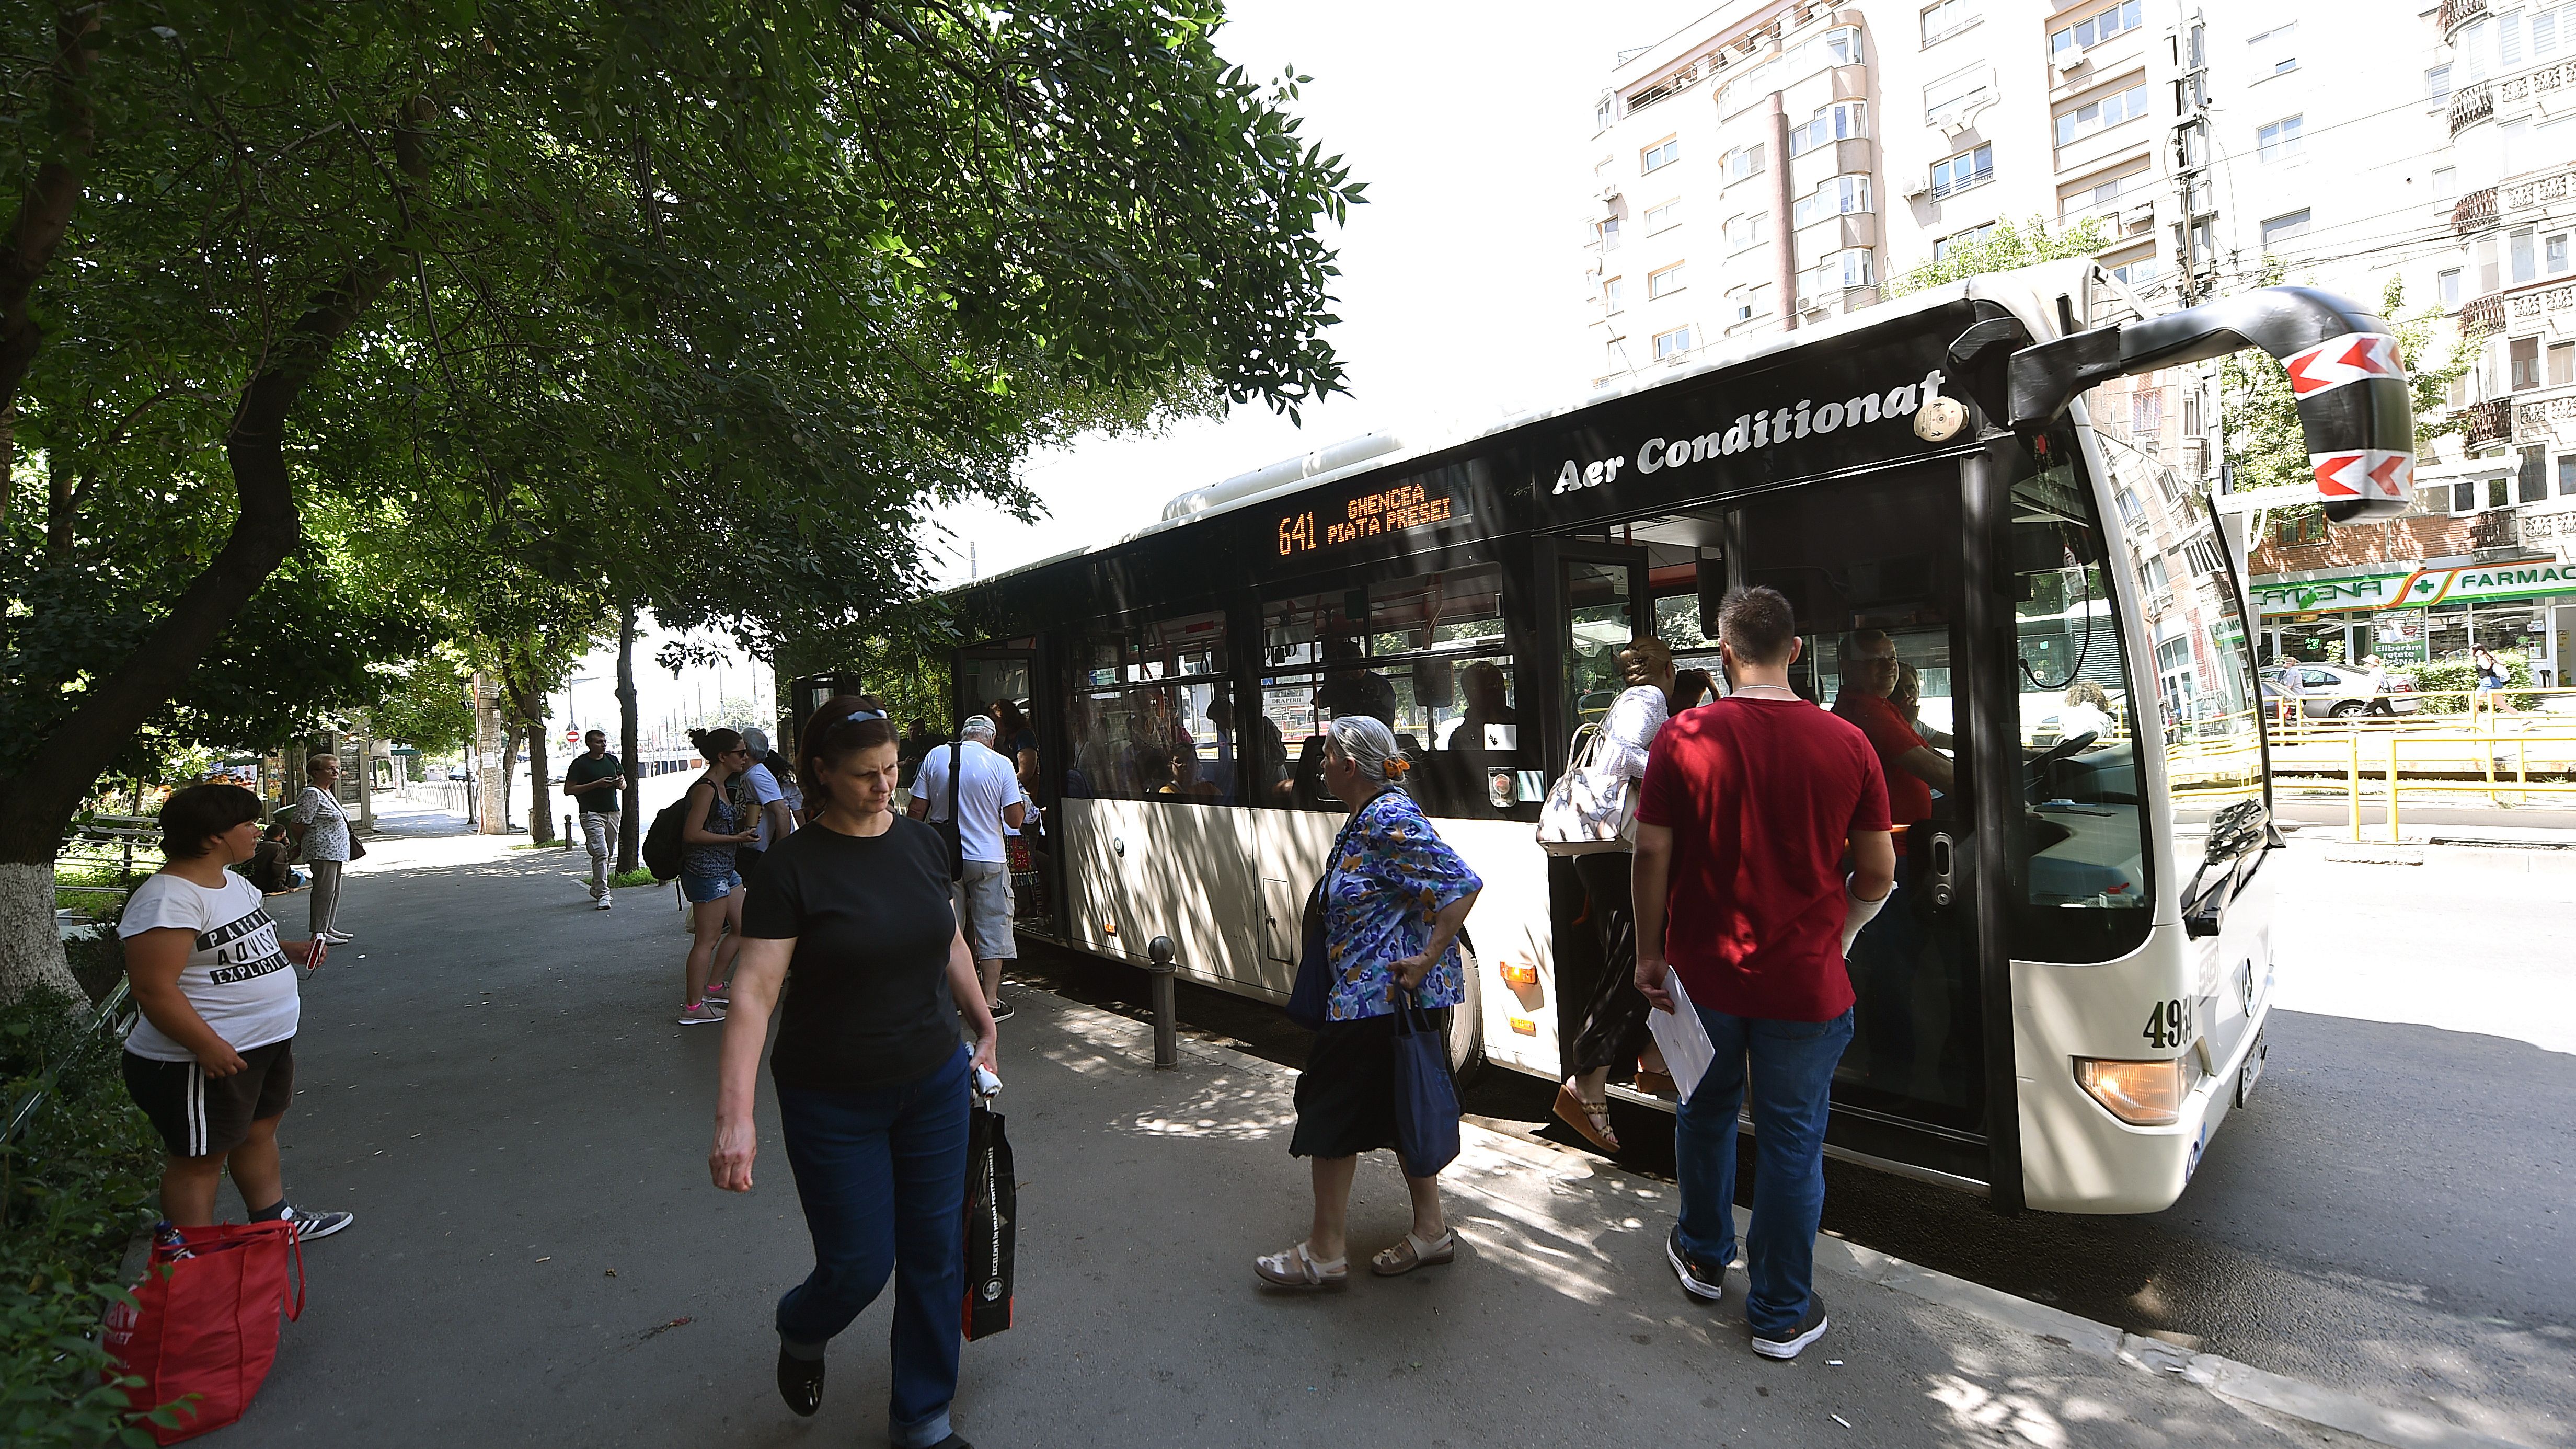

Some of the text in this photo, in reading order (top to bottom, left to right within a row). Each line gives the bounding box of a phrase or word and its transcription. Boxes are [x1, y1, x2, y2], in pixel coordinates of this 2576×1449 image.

[1552, 369, 1947, 496] Aer Conditionat
[1327, 497, 1451, 545] PIATA PRESEI
[1348, 482, 1425, 519] GHENCEA
[1279, 511, 1317, 556] 641
[2461, 566, 2576, 589] FARMAC
[216, 956, 281, 984] EXPLICIT
